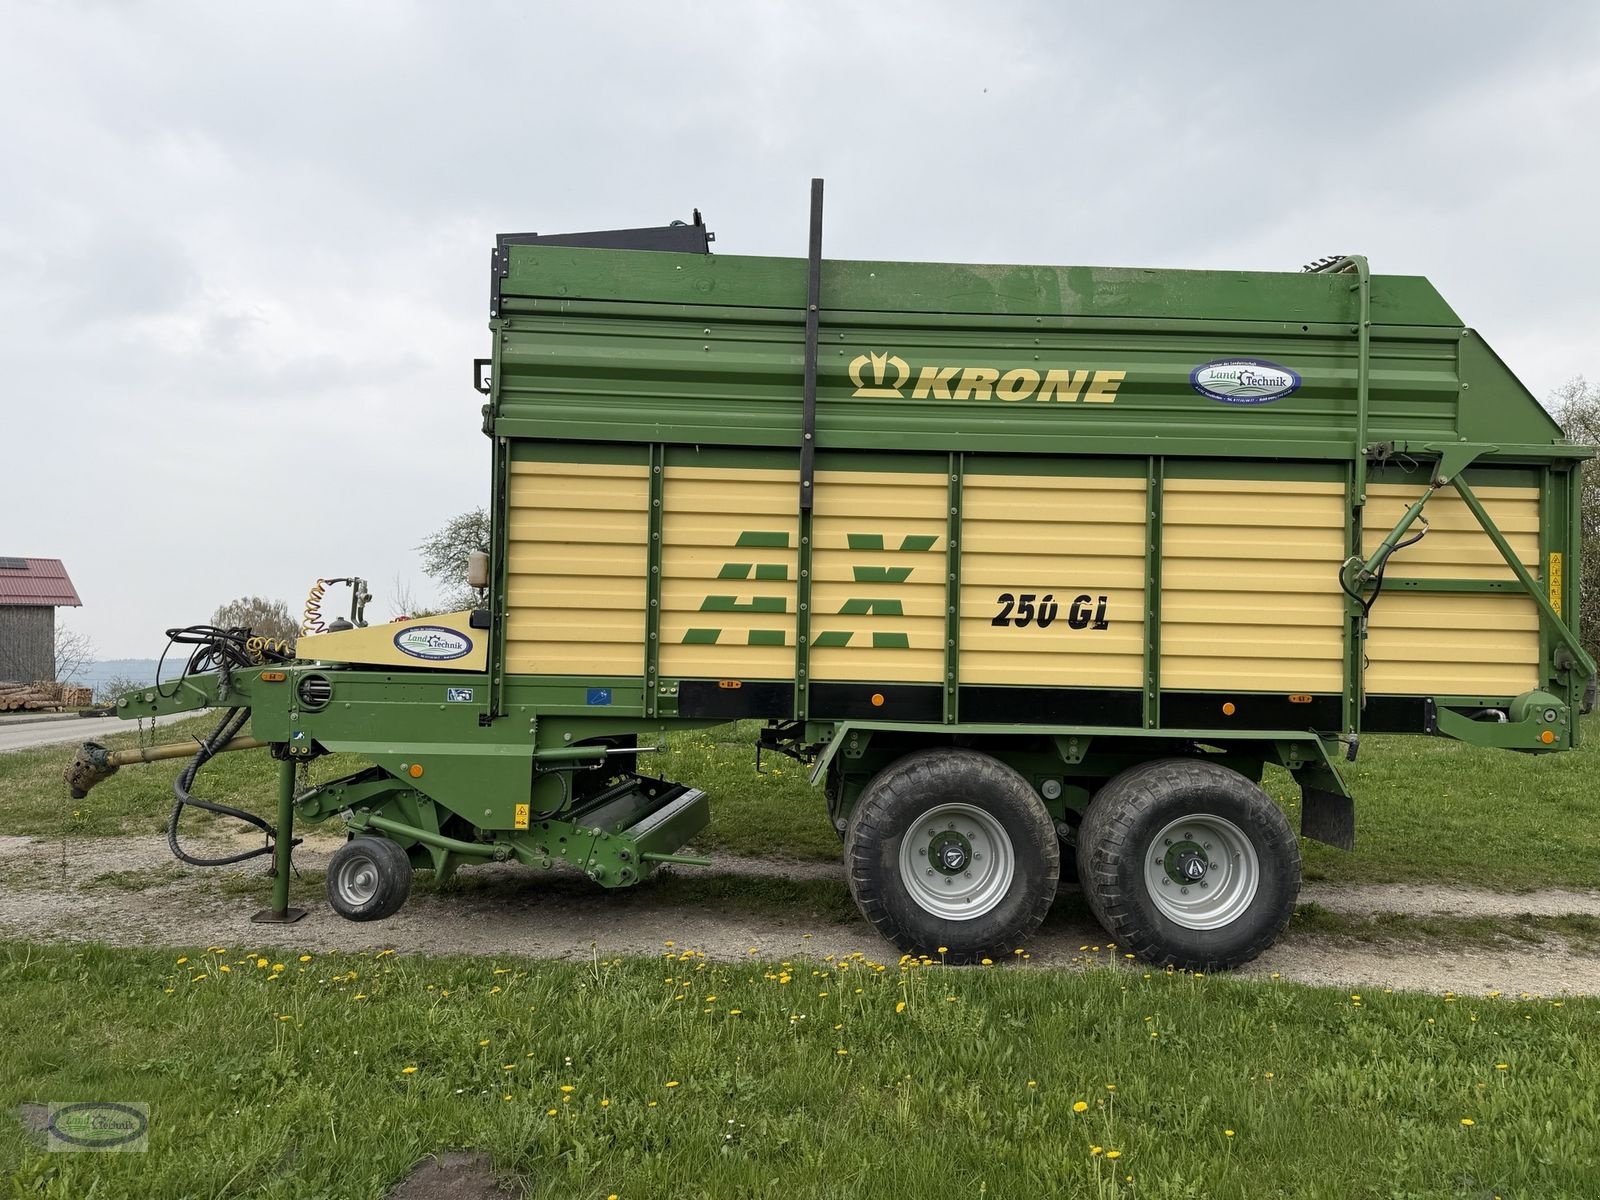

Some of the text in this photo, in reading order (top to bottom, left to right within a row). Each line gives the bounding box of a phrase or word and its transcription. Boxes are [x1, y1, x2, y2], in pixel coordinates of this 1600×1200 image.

[911, 366, 1127, 403] KRONE
[1209, 370, 1287, 387] Land Technik
[991, 593, 1109, 631] 250 GL
[407, 634, 463, 650] Land Technik
